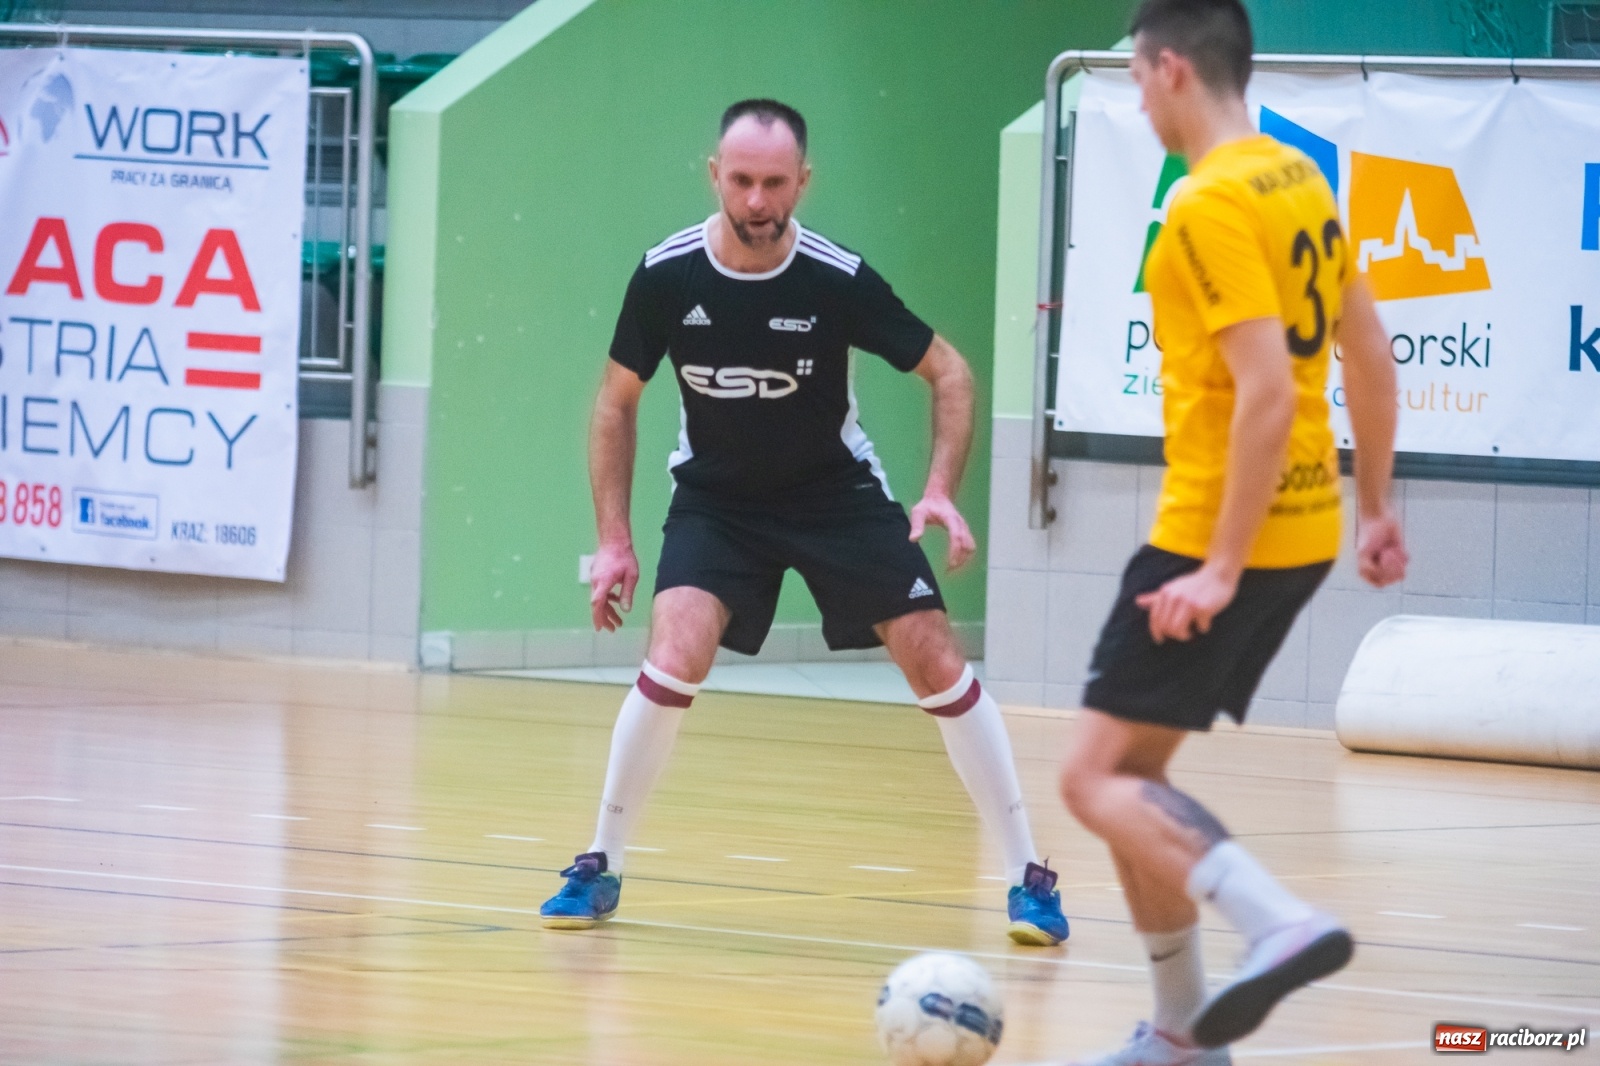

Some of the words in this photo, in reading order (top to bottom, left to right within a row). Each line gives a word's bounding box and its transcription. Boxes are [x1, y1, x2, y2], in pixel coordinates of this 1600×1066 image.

[84, 103, 271, 160] WORK
[0, 316, 169, 385] TRIA
[1389, 322, 1491, 369] orski
[681, 365, 798, 399] ESD
